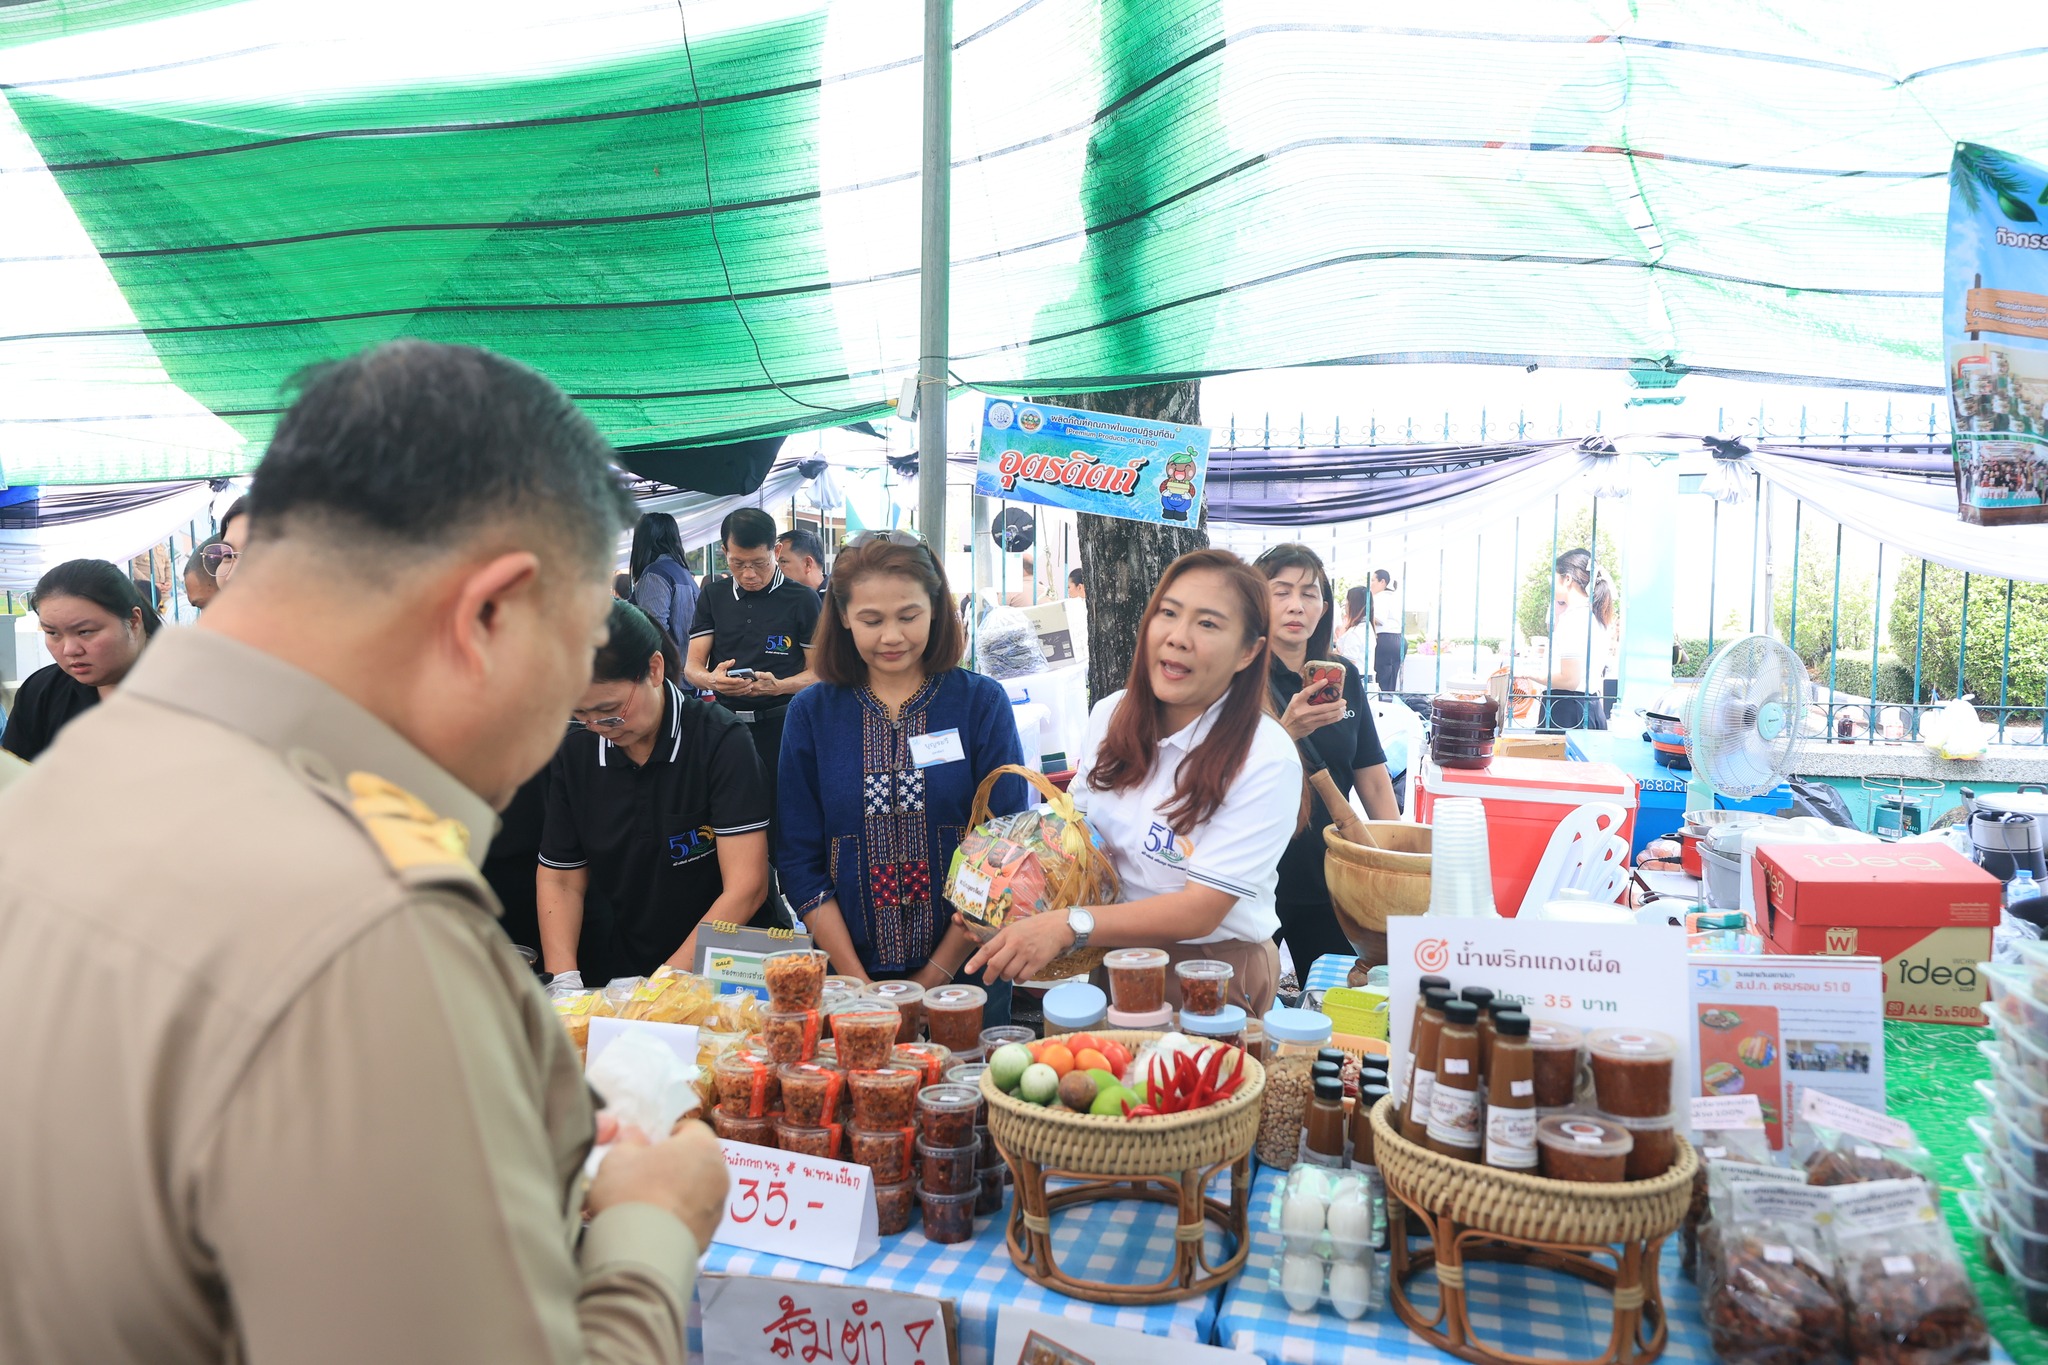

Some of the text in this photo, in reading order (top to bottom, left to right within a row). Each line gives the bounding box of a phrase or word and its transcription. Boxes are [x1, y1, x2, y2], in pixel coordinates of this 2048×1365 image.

[1051, 415, 1175, 439] ผลิตภัณฑ์คุณภาพในเขตปฏิรูปที่ดิน
[1066, 427, 1096, 438] (Premium
[1098, 432, 1126, 442] Products
[1137, 439, 1158, 447] ALRO)
[1000, 450, 1147, 492] อุตรดิตถ์
[669, 829, 701, 859] 51
[1144, 821, 1175, 852] 51
[1804, 853, 1943, 868] idea
[1457, 941, 1621, 973] น้ำพริกแกงเผ็ด
[1828, 936, 1851, 951] W
[1899, 958, 1976, 986] idea
[1824, 982, 1838, 992] 51
[1544, 995, 1572, 1009] 35
[1582, 998, 1617, 1012] บาท
[1907, 1004, 1928, 1015] A4
[1934, 1005, 1979, 1018] 5x500
[722, 1147, 780, 1177] ้ำพริกกากหมู
[730, 1179, 824, 1230] 35.-
[763, 1295, 887, 1365] ส้มตำ
